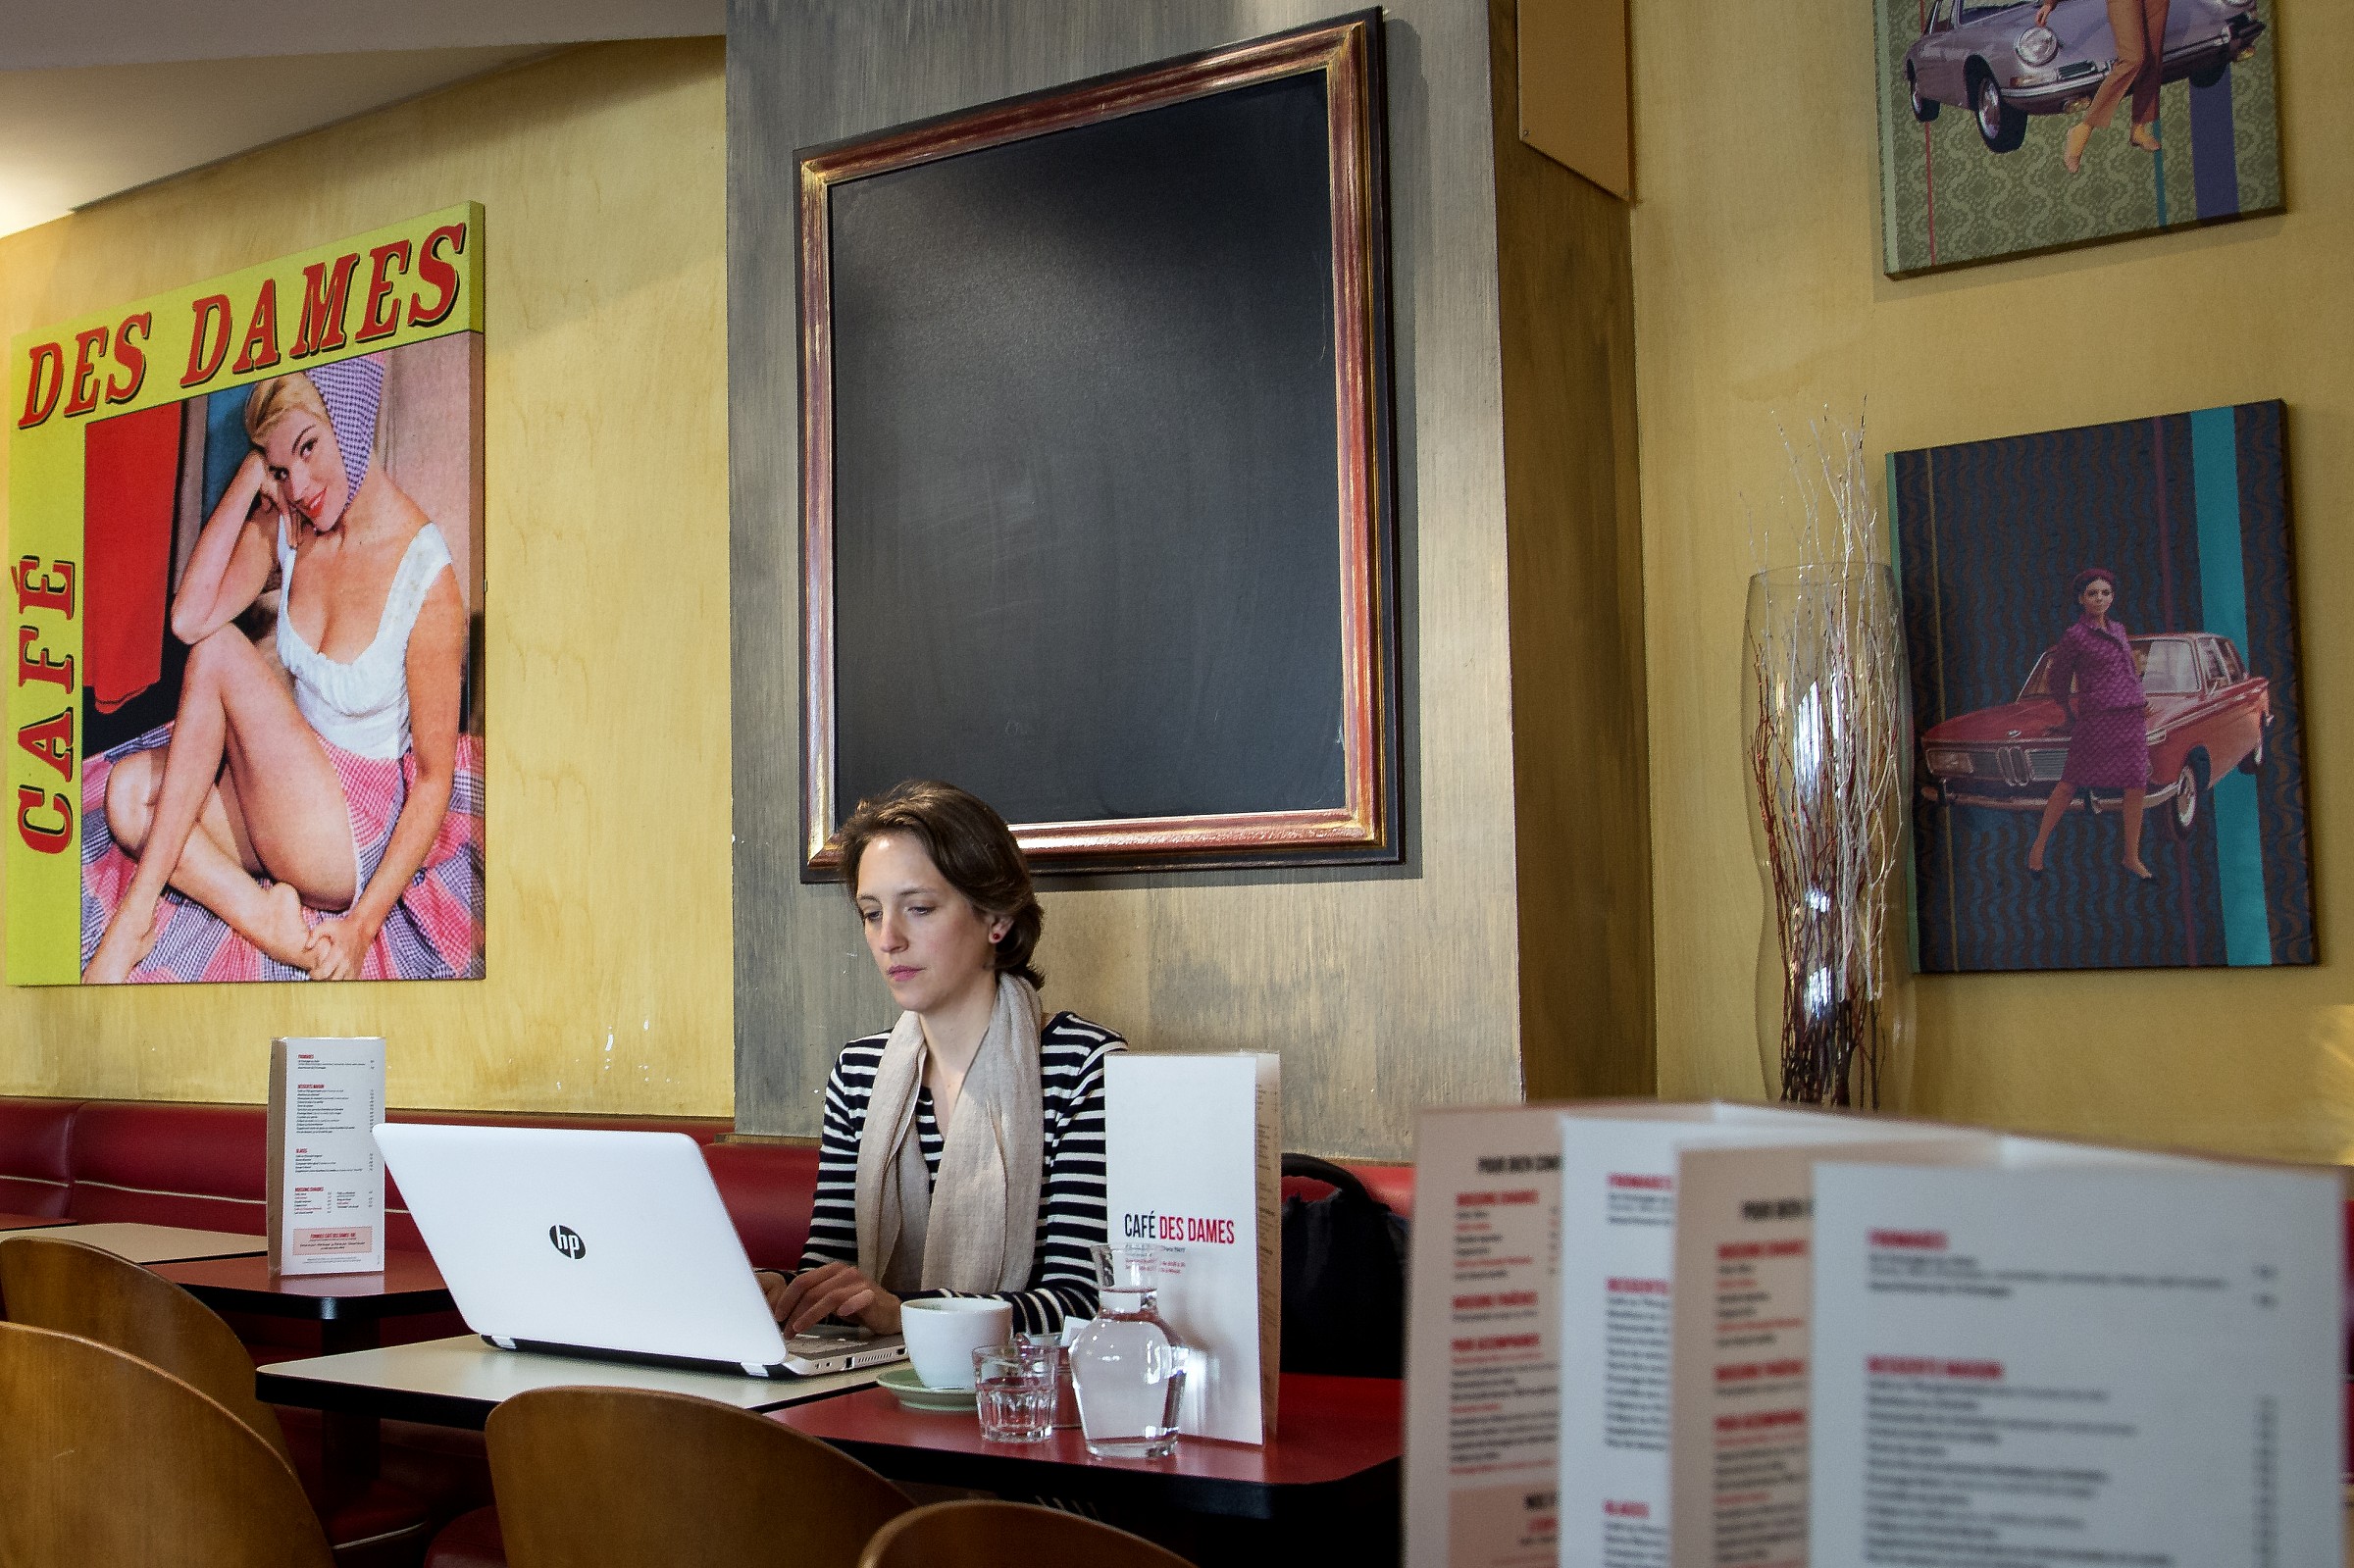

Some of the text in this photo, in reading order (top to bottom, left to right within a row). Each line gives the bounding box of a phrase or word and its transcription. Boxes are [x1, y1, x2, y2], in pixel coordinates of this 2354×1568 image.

[18, 222, 466, 429] DES DAMES
[11, 554, 76, 855] CAFÉ
[552, 1224, 583, 1260] hp
[1124, 1210, 1236, 1244] CAFÉ DES DAMES
